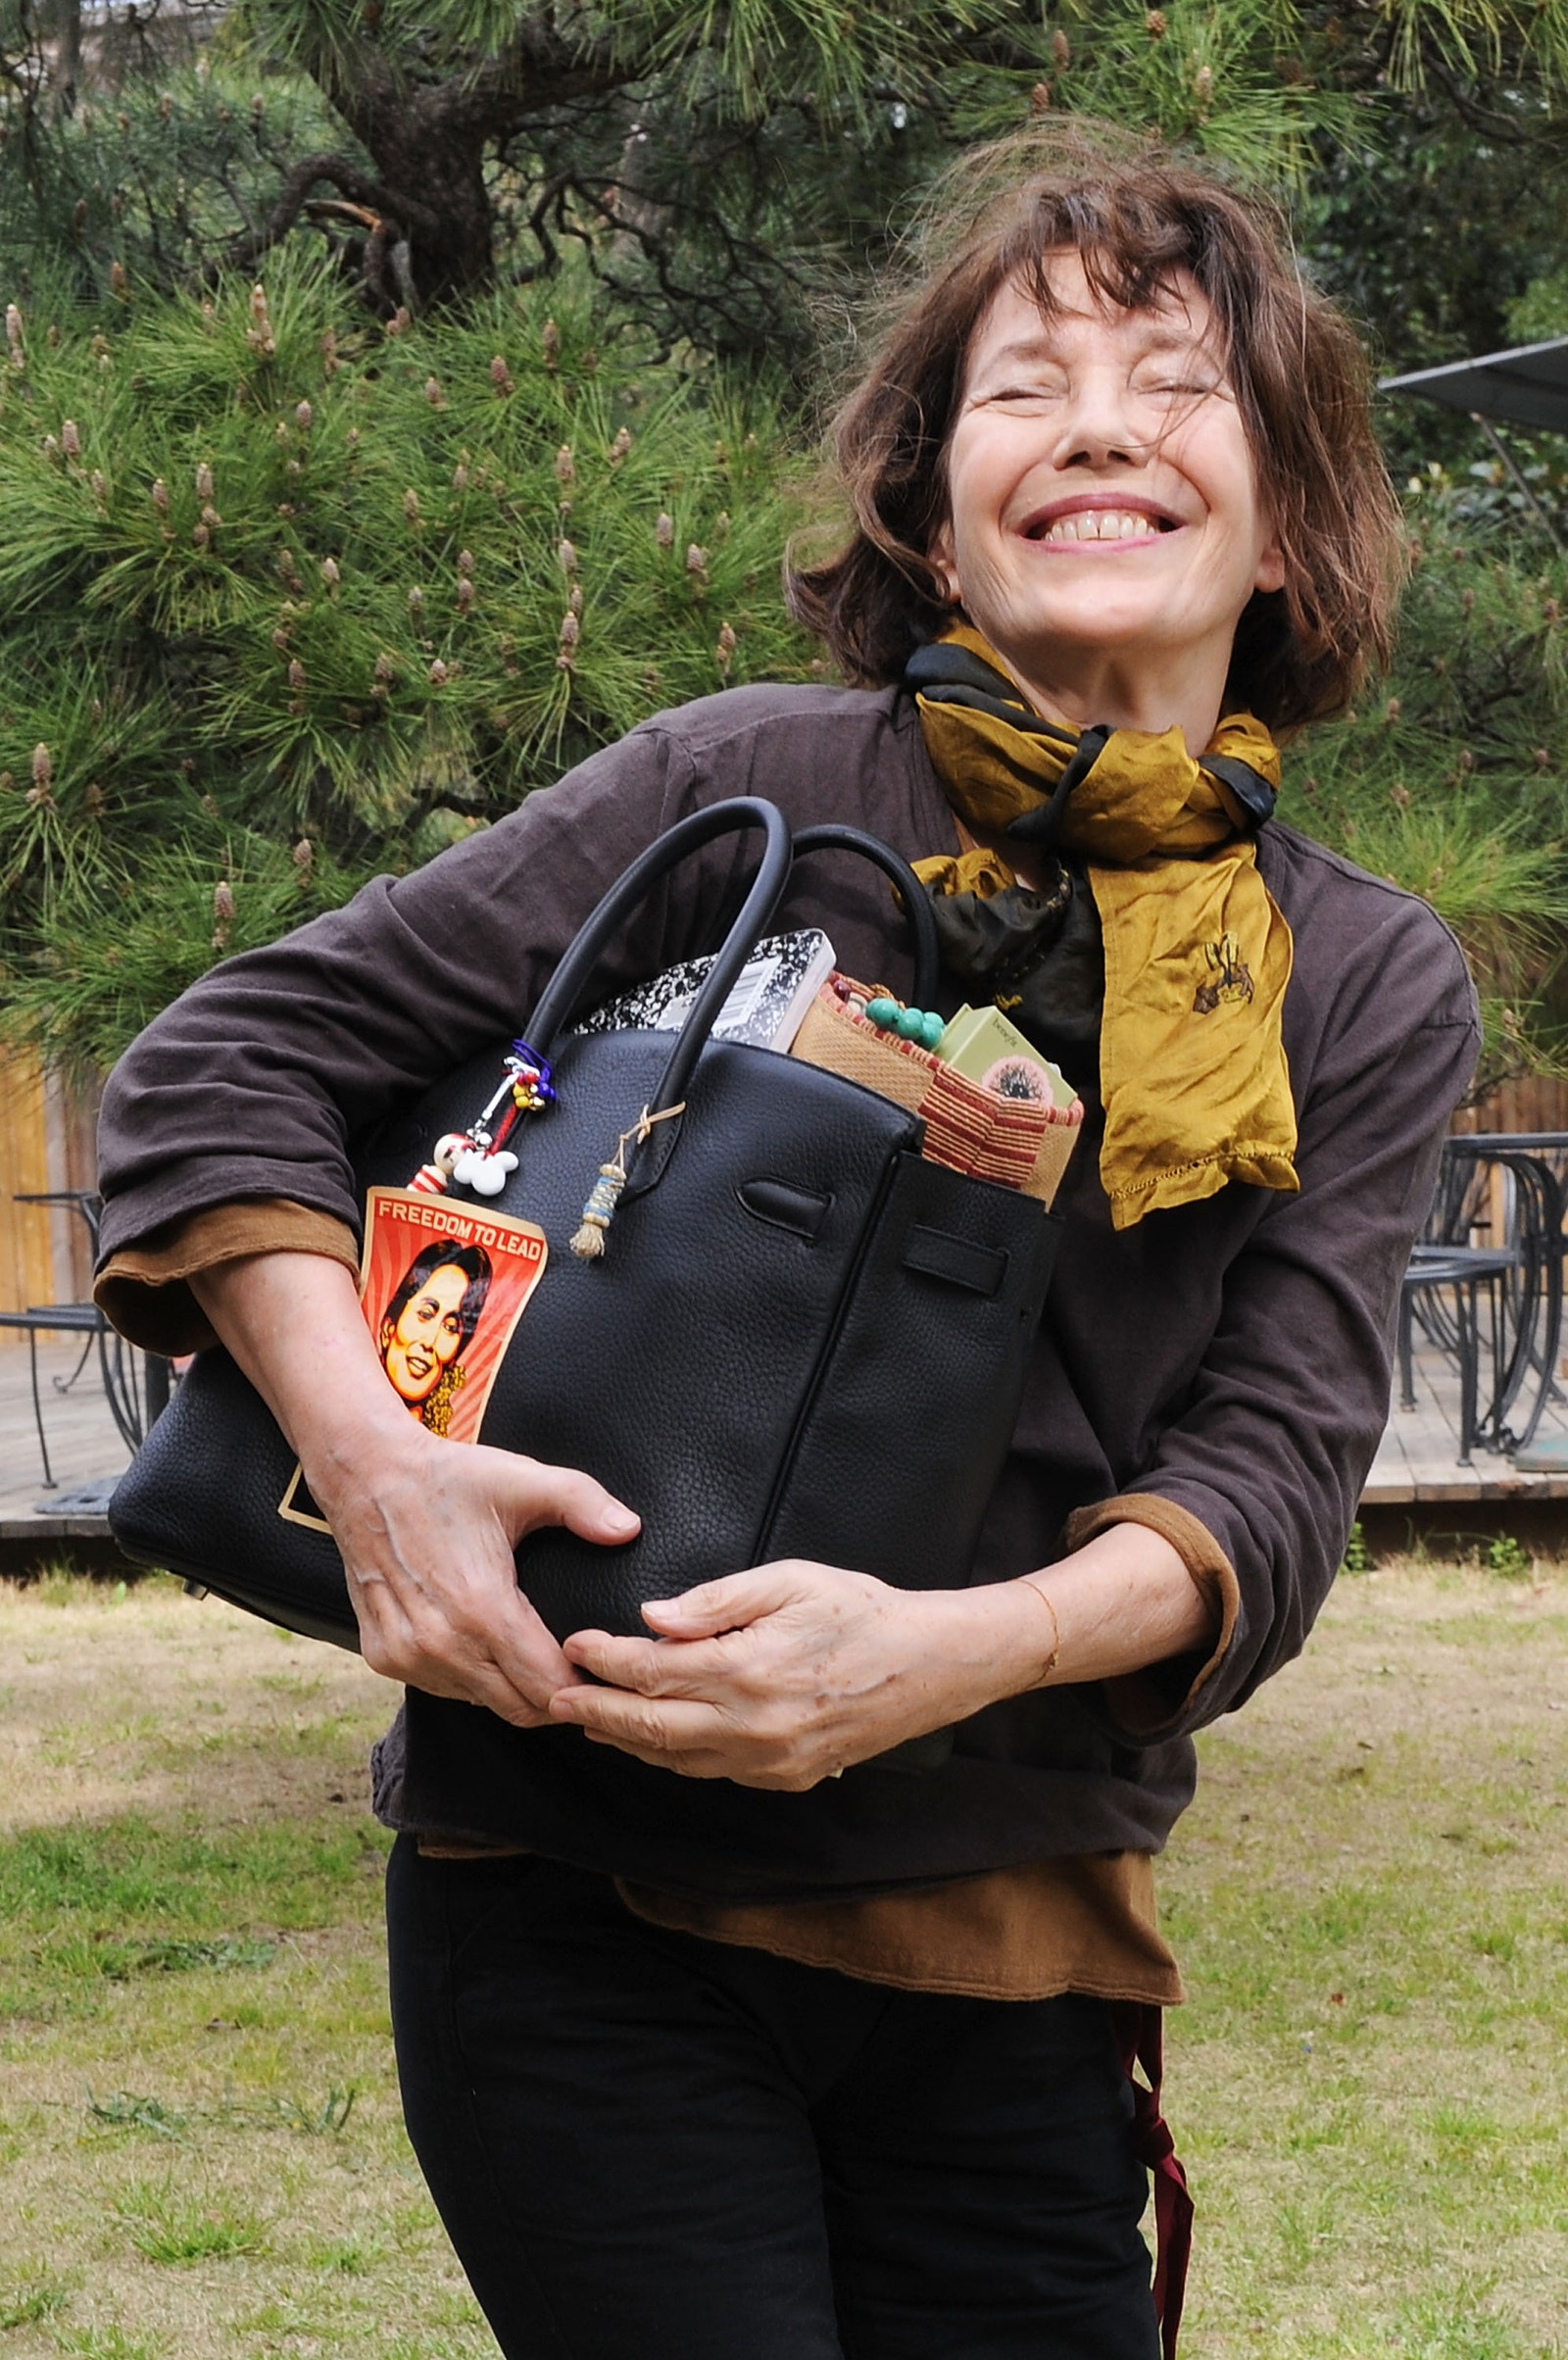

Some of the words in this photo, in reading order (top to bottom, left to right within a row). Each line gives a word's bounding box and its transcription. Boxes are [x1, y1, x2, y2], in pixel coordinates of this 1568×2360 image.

[378, 1201, 473, 1239] FREEDOM
[474, 1224, 497, 1247] TO
[496, 1232, 541, 1261] LEAD
